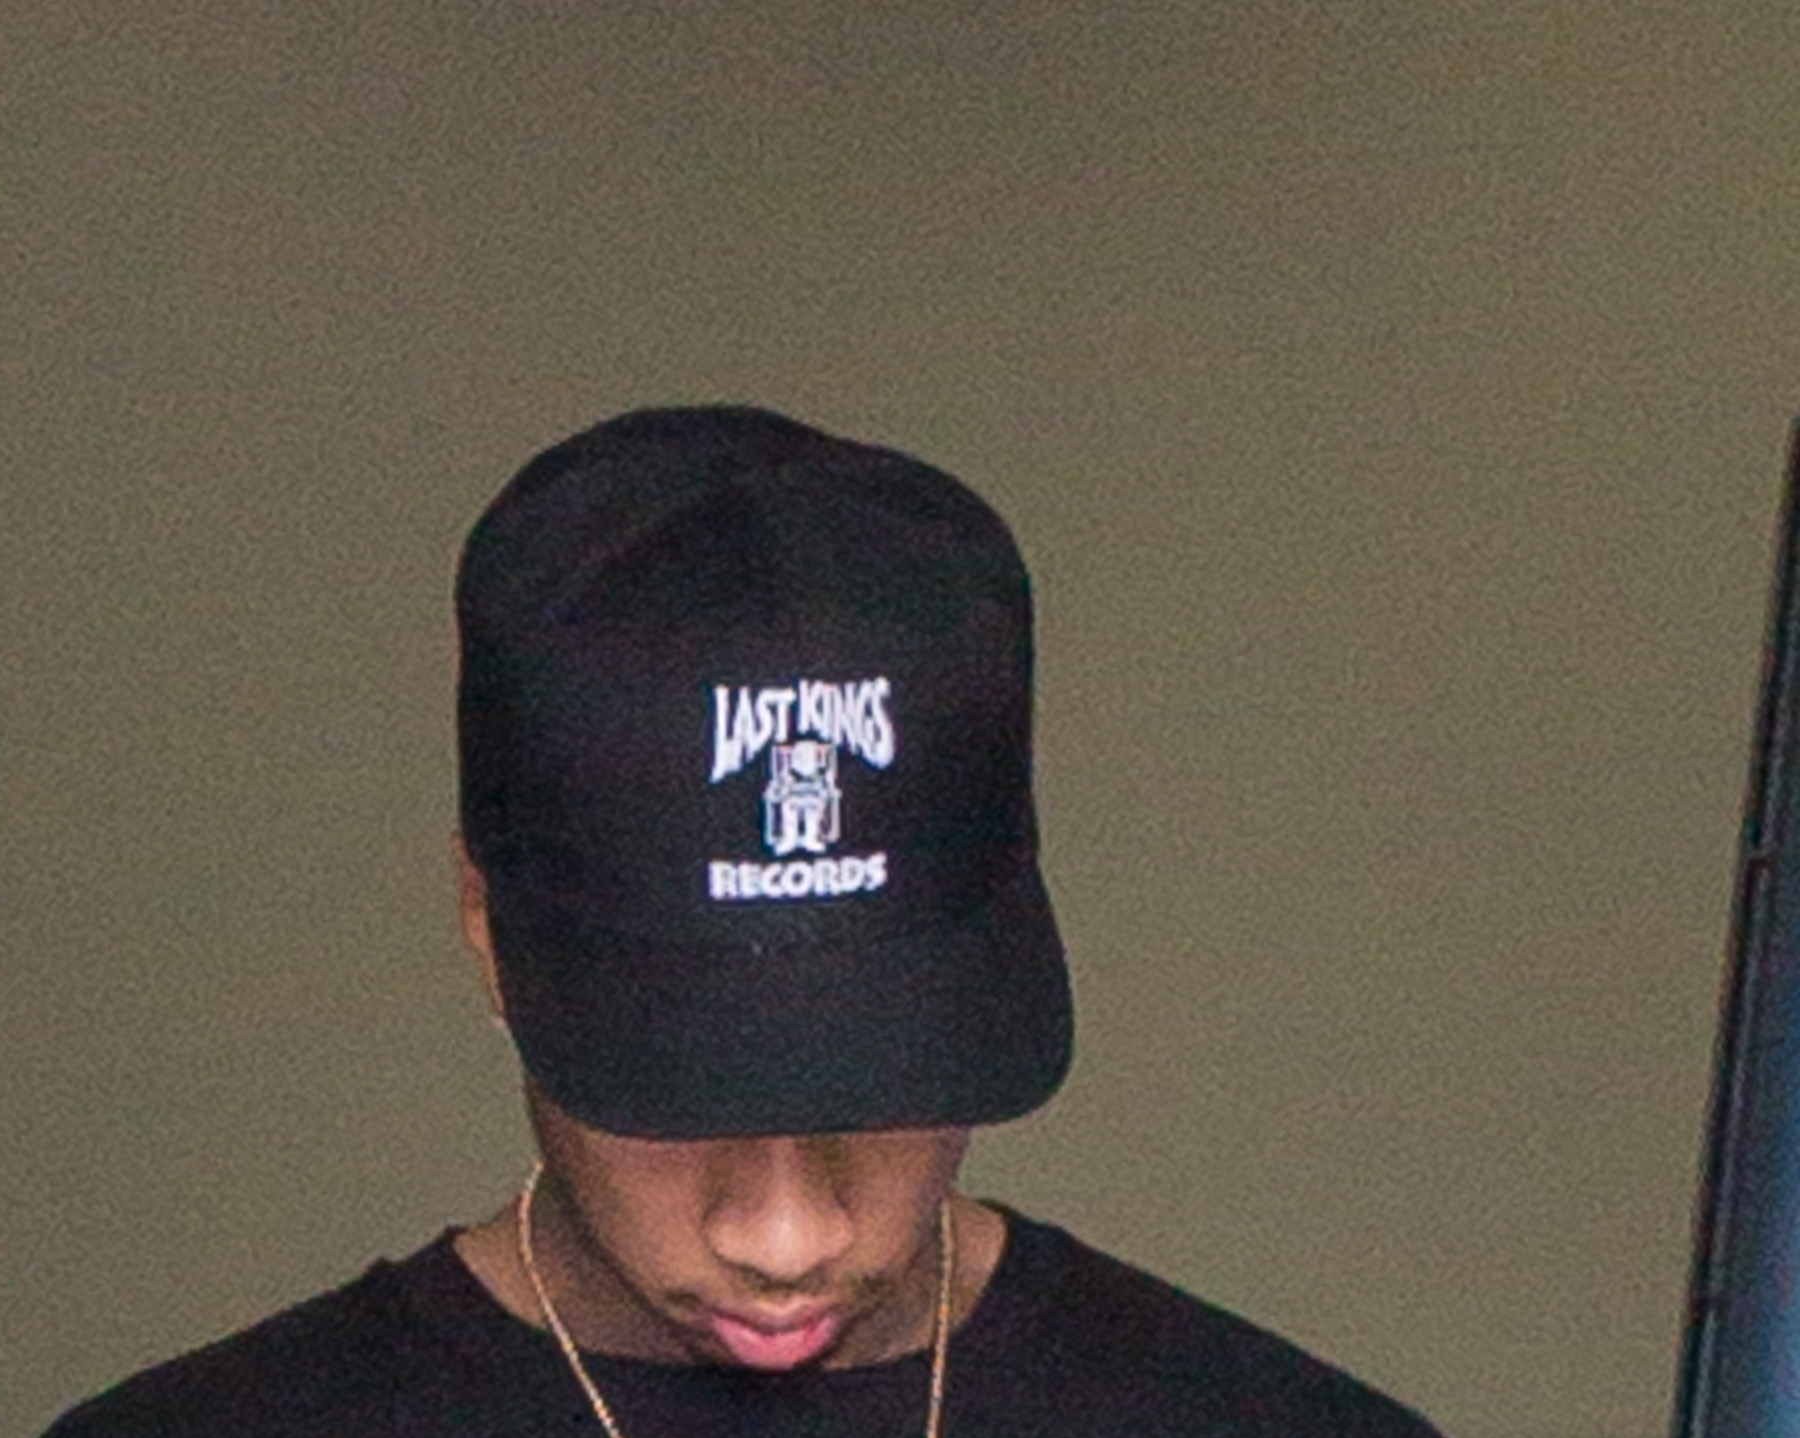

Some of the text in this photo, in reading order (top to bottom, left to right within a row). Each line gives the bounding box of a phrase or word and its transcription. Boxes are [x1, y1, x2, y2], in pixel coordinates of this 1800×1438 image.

[709, 676, 895, 784] LAST KINGS
[708, 852, 887, 898] RECORDS
